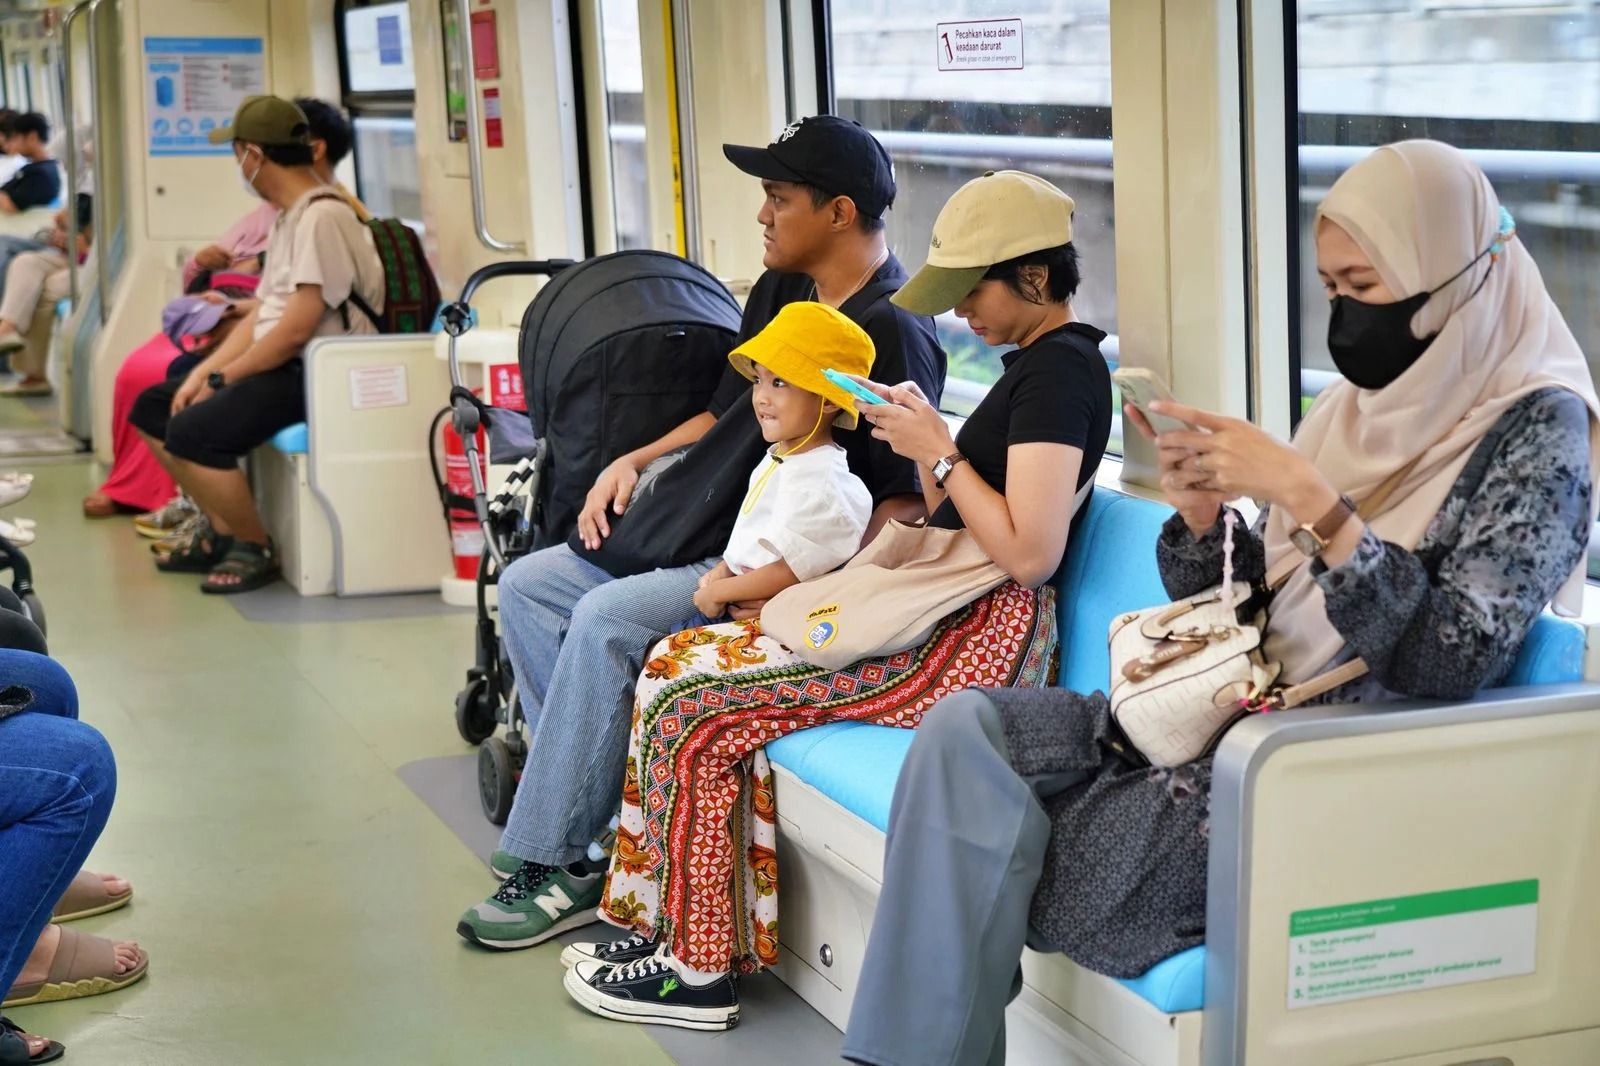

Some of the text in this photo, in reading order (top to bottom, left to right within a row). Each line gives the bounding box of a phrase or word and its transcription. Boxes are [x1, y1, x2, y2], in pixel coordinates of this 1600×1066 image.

[955, 26, 1016, 39] Pecahkan kaca dalam
[956, 40, 1002, 51] keadaan darurat
[533, 884, 575, 920] N
[1295, 966, 1304, 976] 2.
[1294, 988, 1304, 999] 3.
